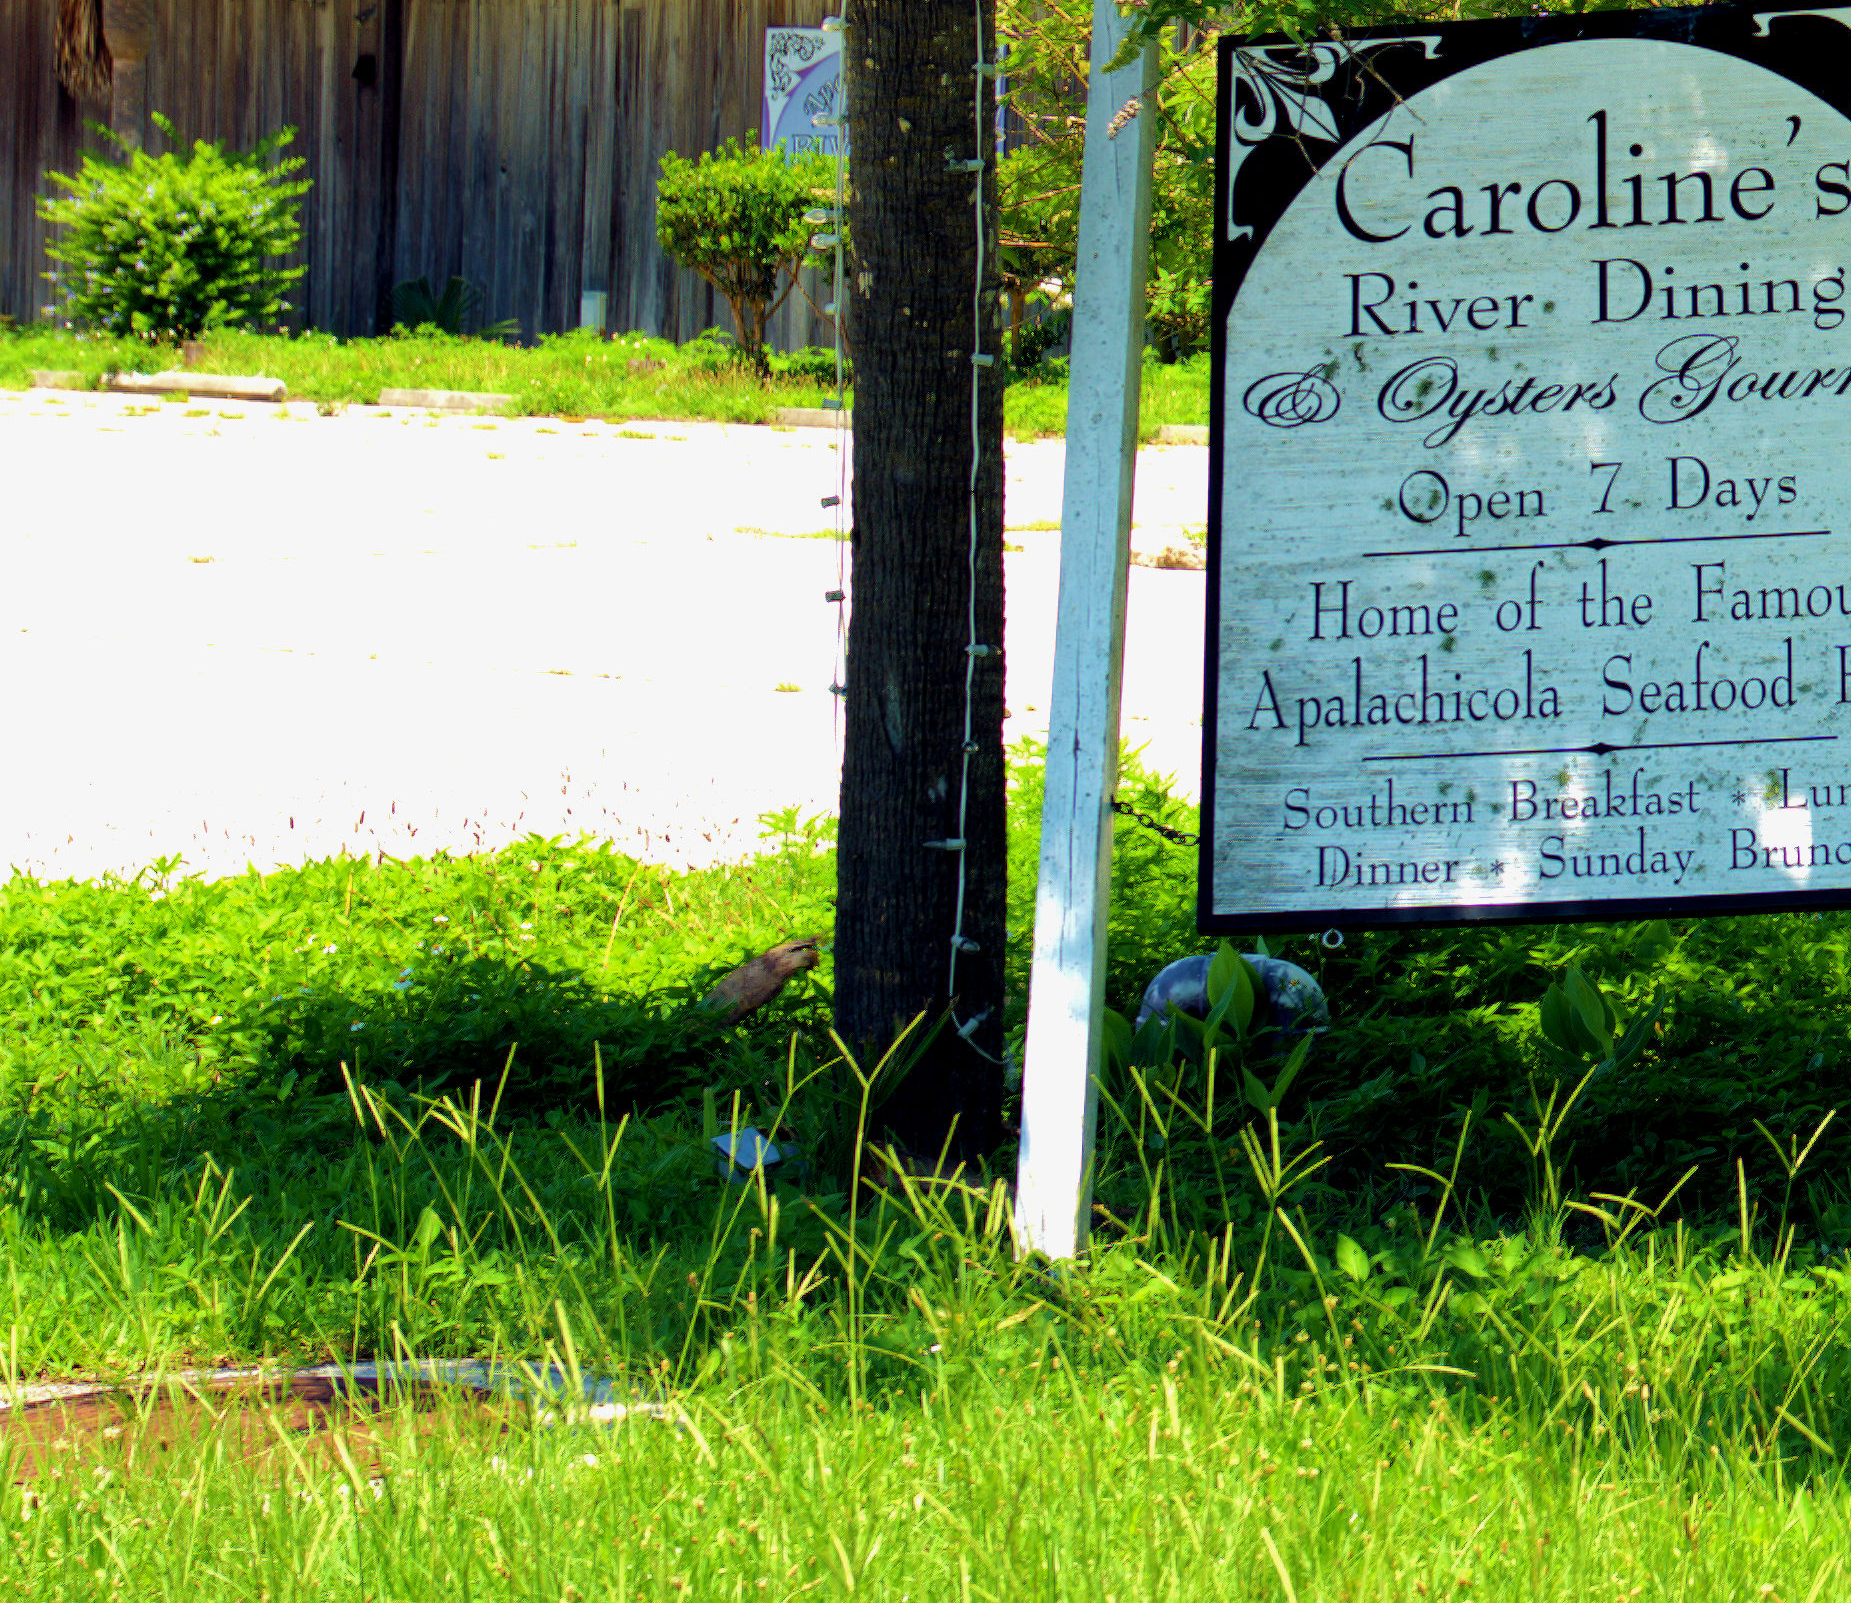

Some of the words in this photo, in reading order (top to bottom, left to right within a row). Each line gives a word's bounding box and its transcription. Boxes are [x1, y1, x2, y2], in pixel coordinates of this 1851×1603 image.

[1343, 272, 1534, 338] River
[1589, 257, 1847, 329] Dining
[1242, 362, 1341, 428] &
[1378, 355, 1619, 449] Oysters
[1397, 469, 1548, 537] Open
[1589, 461, 1624, 515] 7
[1666, 456, 1799, 530] Days
[1308, 579, 1460, 641] Home
[1495, 561, 1545, 632] of
[1577, 558, 1654, 629] the
[1244, 650, 1562, 747] Apalachicola
[1602, 638, 1798, 718] Seafood
[1282, 781, 1475, 832] Southern
[1508, 770, 1702, 822] Breakfast
[1316, 845, 1460, 888] Dinner
[1538, 827, 1693, 884] Sunday
